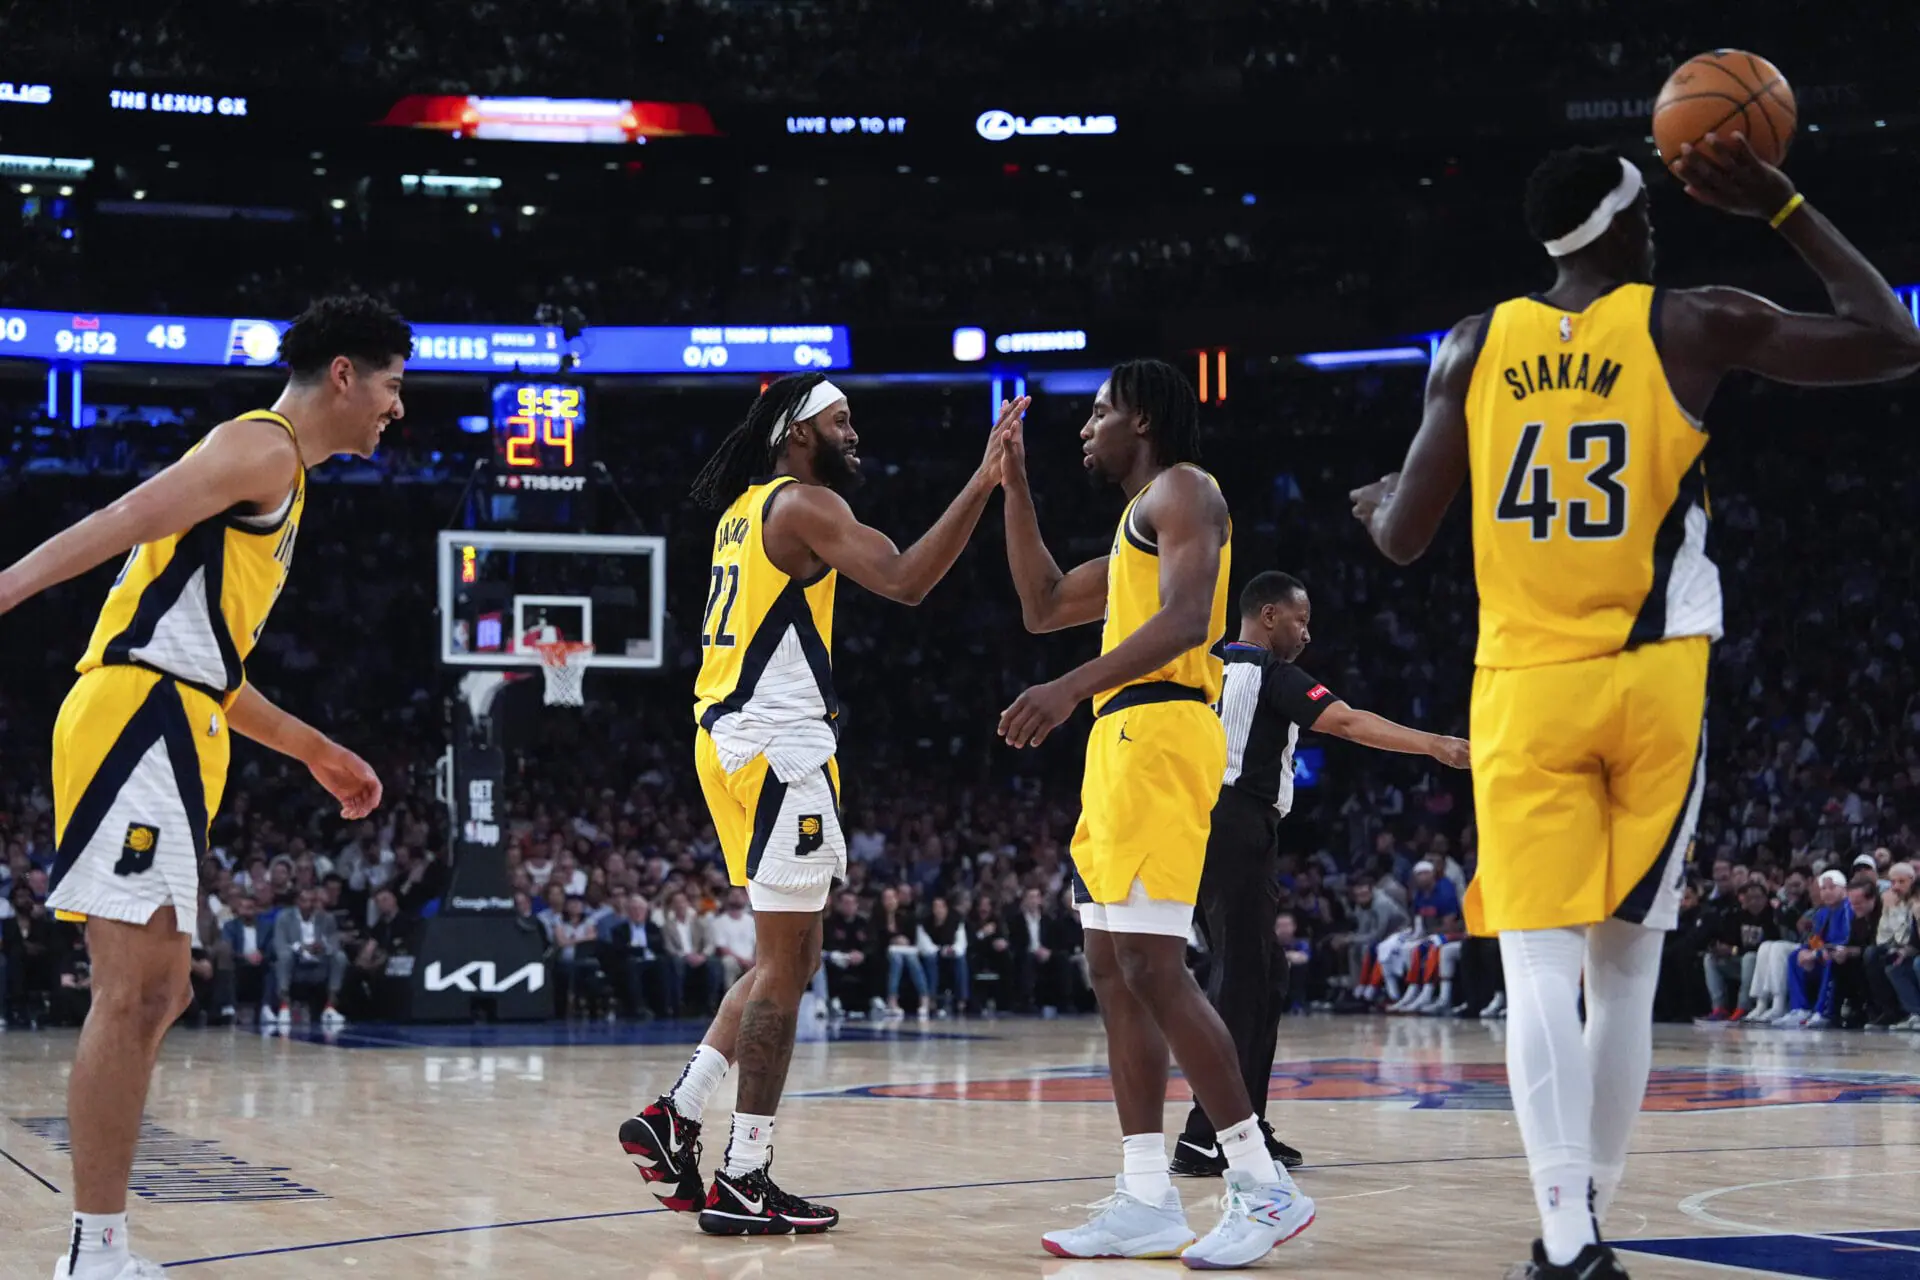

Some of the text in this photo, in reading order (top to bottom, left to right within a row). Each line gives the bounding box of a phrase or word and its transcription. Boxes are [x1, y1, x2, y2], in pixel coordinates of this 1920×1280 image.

[110, 90, 247, 116] THE LEXUS GX
[787, 116, 906, 134] LIVE UP TO IT
[1015, 115, 1117, 134] LEXUS
[55, 329, 117, 354] 9:52
[146, 324, 187, 349] 45
[683, 345, 729, 368] 0/0
[793, 344, 833, 367] 0%
[1504, 353, 1623, 400] SIAKAM
[517, 387, 580, 418] 9:52
[506, 416, 575, 467] 24
[521, 474, 587, 492] TISSOT
[1495, 420, 1629, 541] 43
[702, 564, 740, 648] 22
[424, 961, 545, 992] KIA
